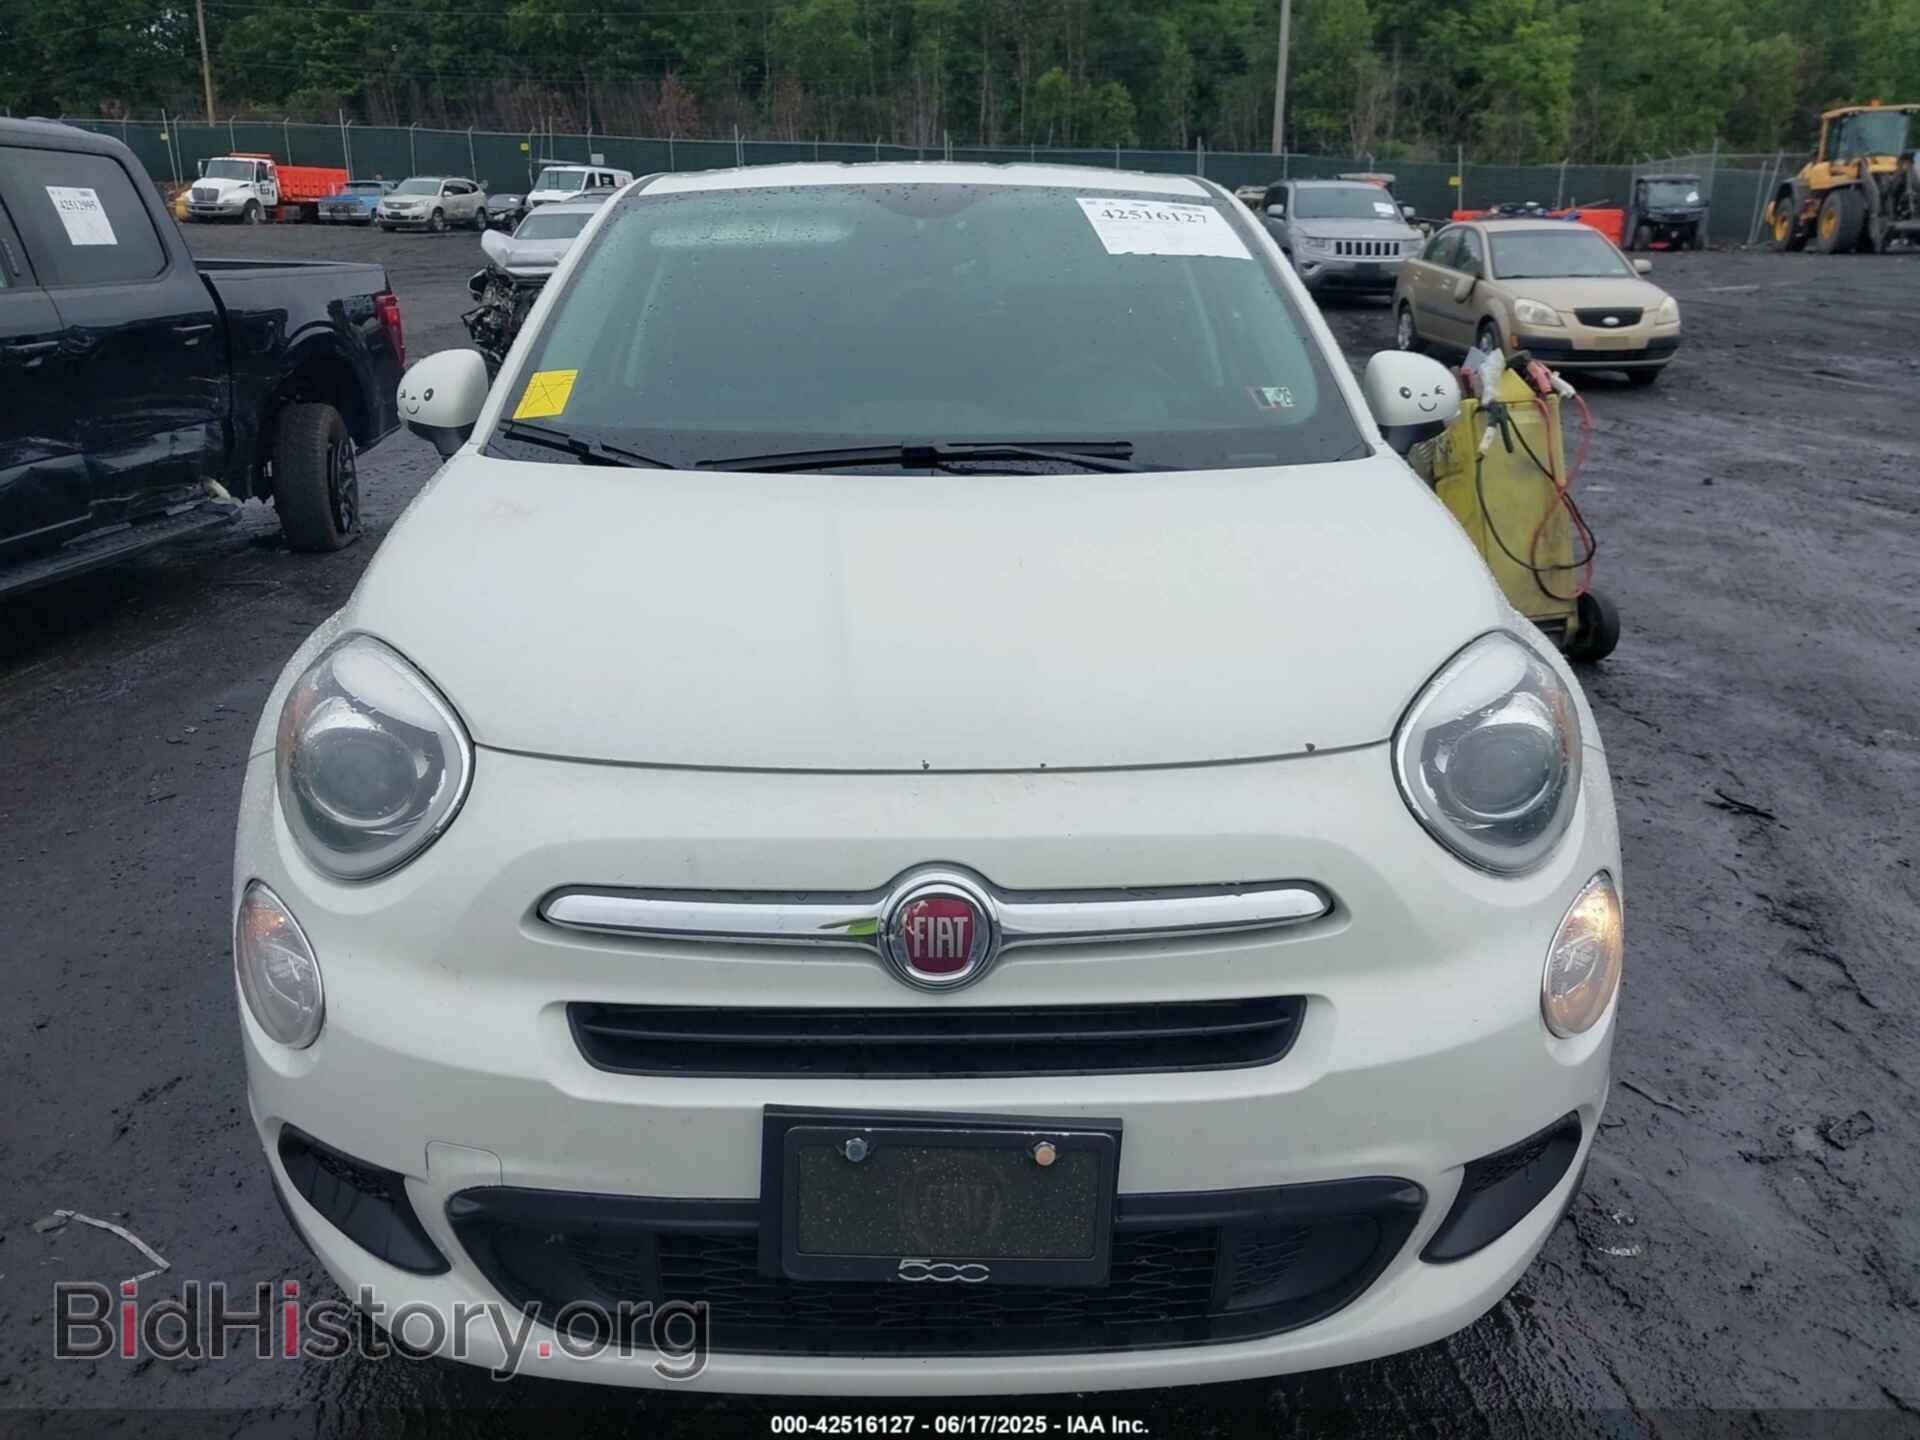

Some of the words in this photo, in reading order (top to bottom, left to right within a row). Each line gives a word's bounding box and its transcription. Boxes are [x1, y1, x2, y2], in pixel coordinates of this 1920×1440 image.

[1101, 208, 1208, 224] 42516127
[913, 916, 969, 959] FIAT
[898, 1258, 990, 1282] 500
